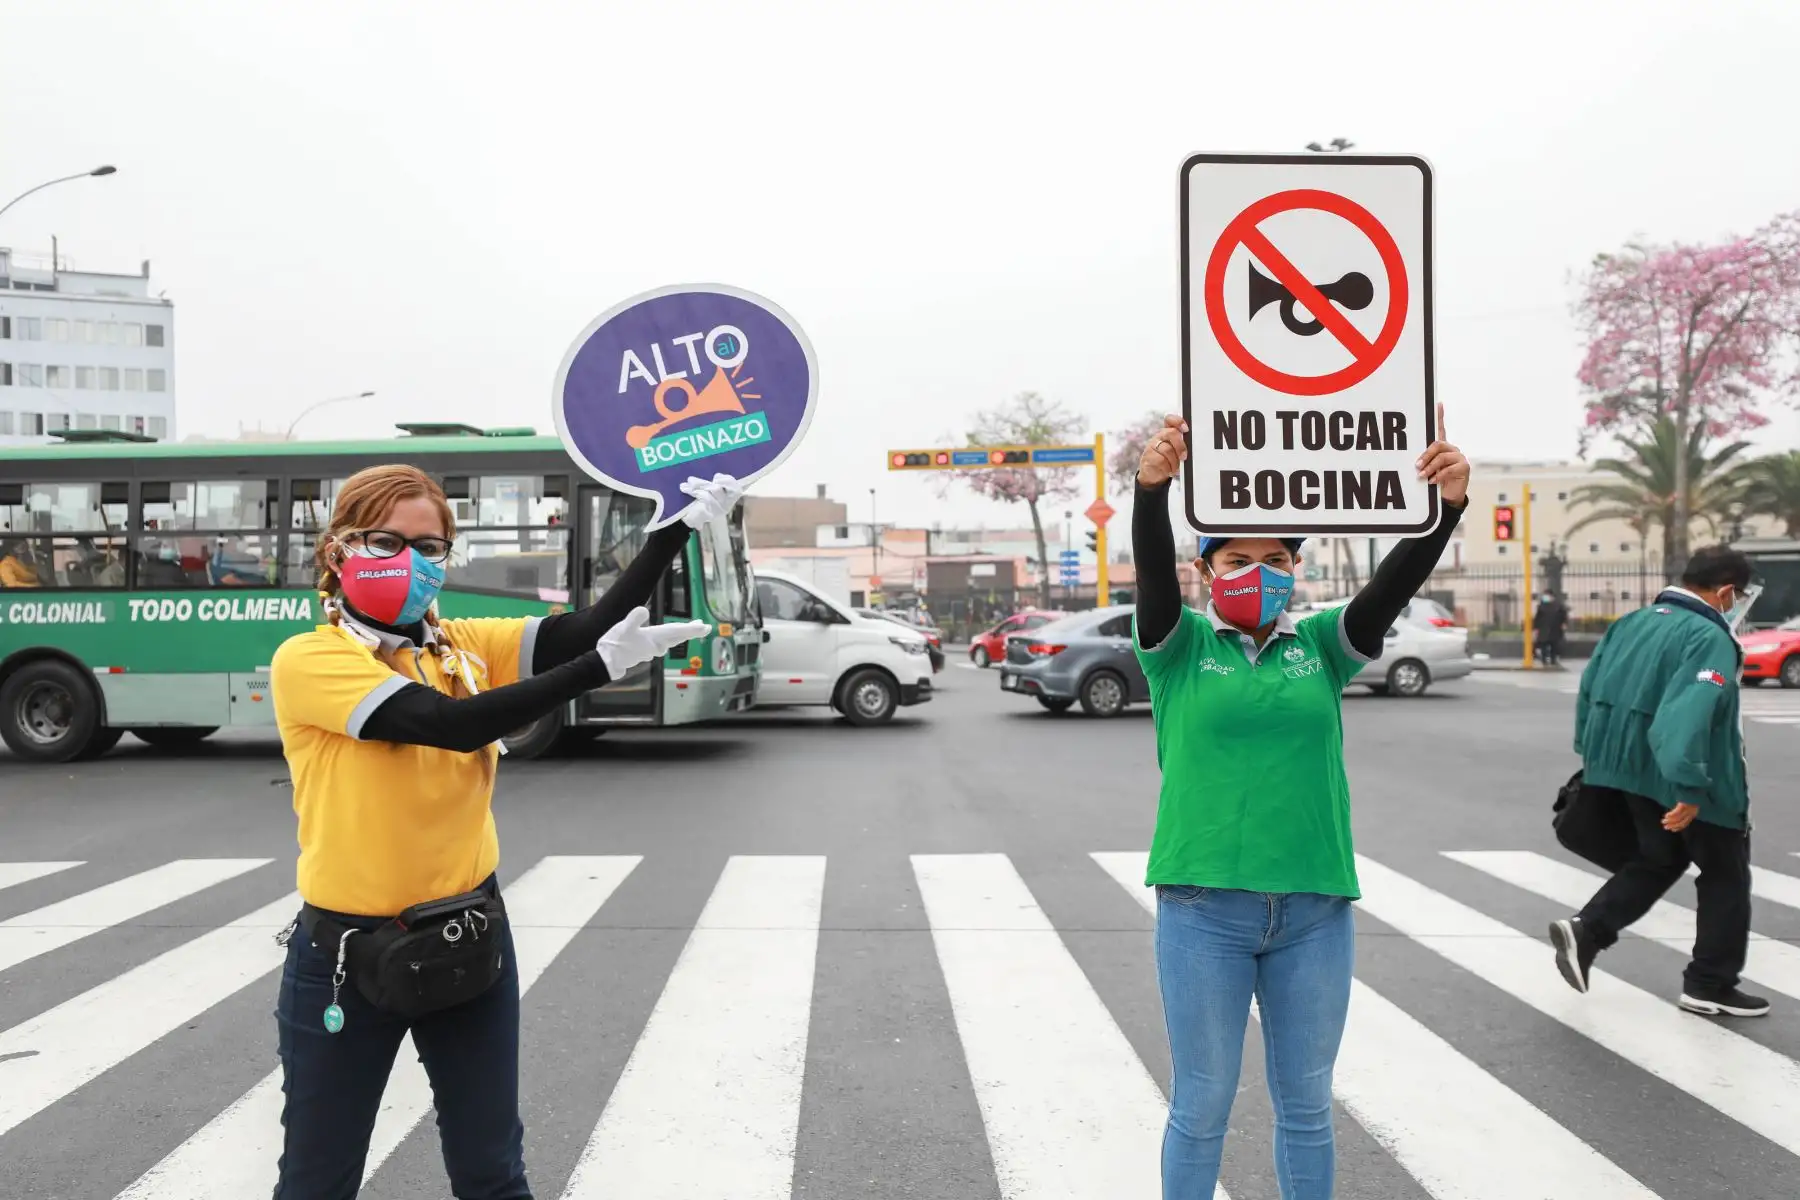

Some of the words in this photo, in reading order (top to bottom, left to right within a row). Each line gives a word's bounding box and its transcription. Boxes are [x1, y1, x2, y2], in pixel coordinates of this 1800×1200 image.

[618, 325, 749, 394] ALTO
[717, 336, 736, 356] al
[640, 419, 764, 467] BOCINAZO
[1213, 410, 1266, 450] NO
[1275, 410, 1408, 451] TOCAR
[1219, 469, 1407, 510] BOCINA
[9, 602, 106, 624] COLONIAL
[128, 599, 192, 622] TODO
[197, 598, 313, 622] COLMENA
